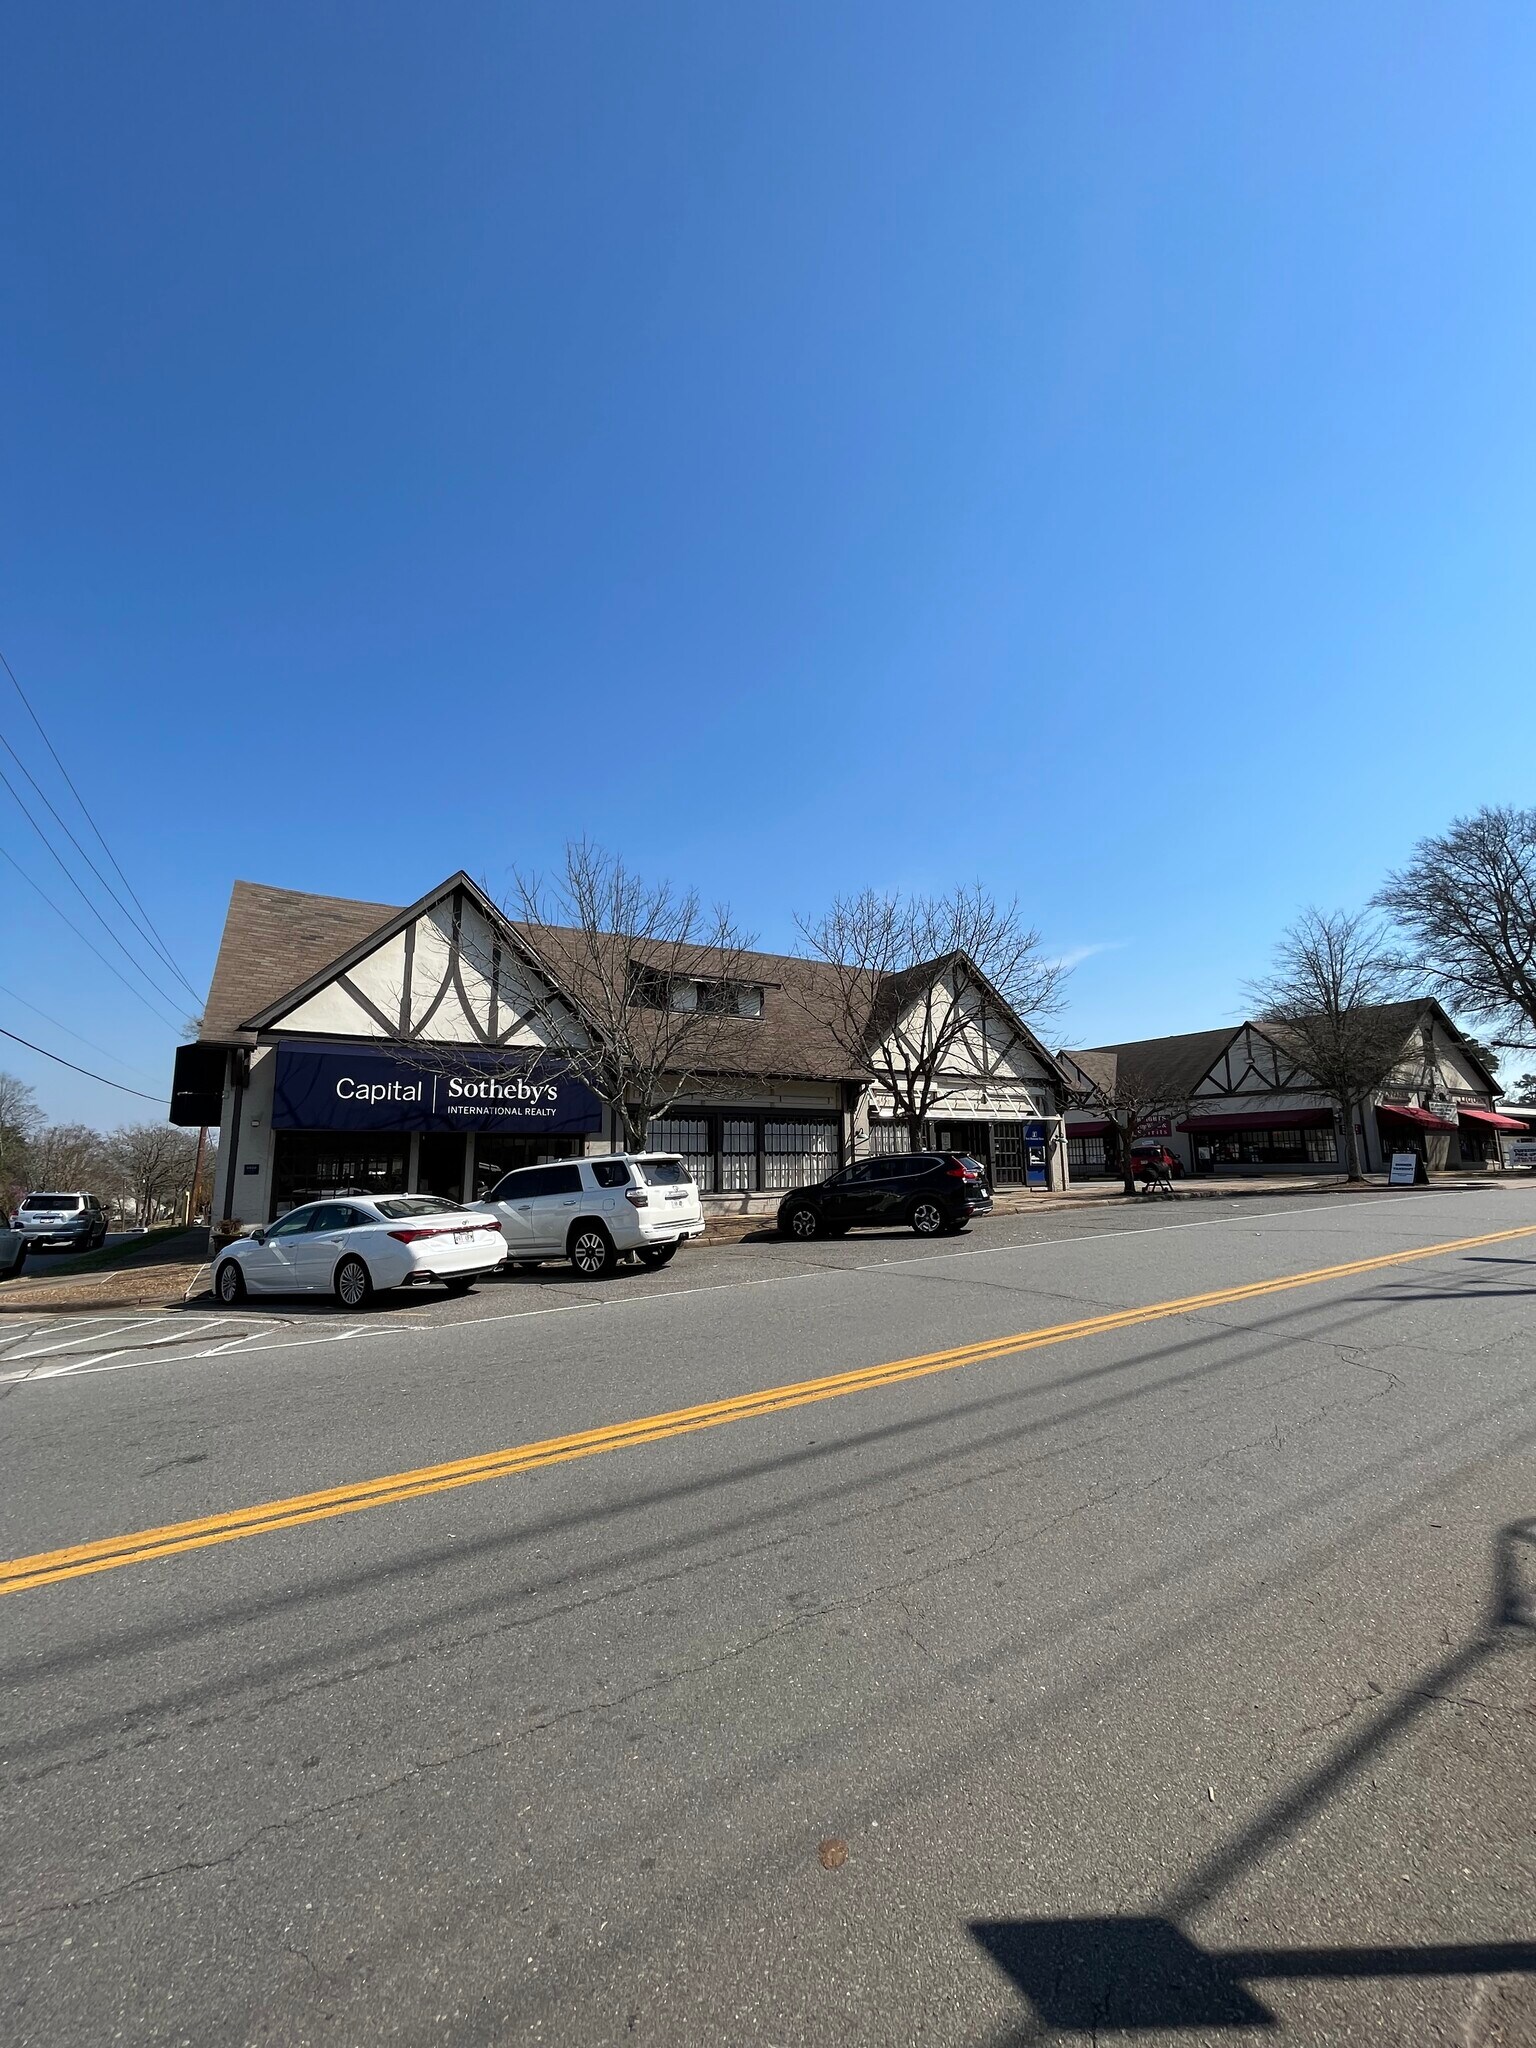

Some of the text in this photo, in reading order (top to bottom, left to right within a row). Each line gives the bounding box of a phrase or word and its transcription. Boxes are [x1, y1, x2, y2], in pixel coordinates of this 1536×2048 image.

[336, 1077, 558, 1105] Capital Sotheby's
[447, 1105, 557, 1117] INTERNATIONAL REALTY
